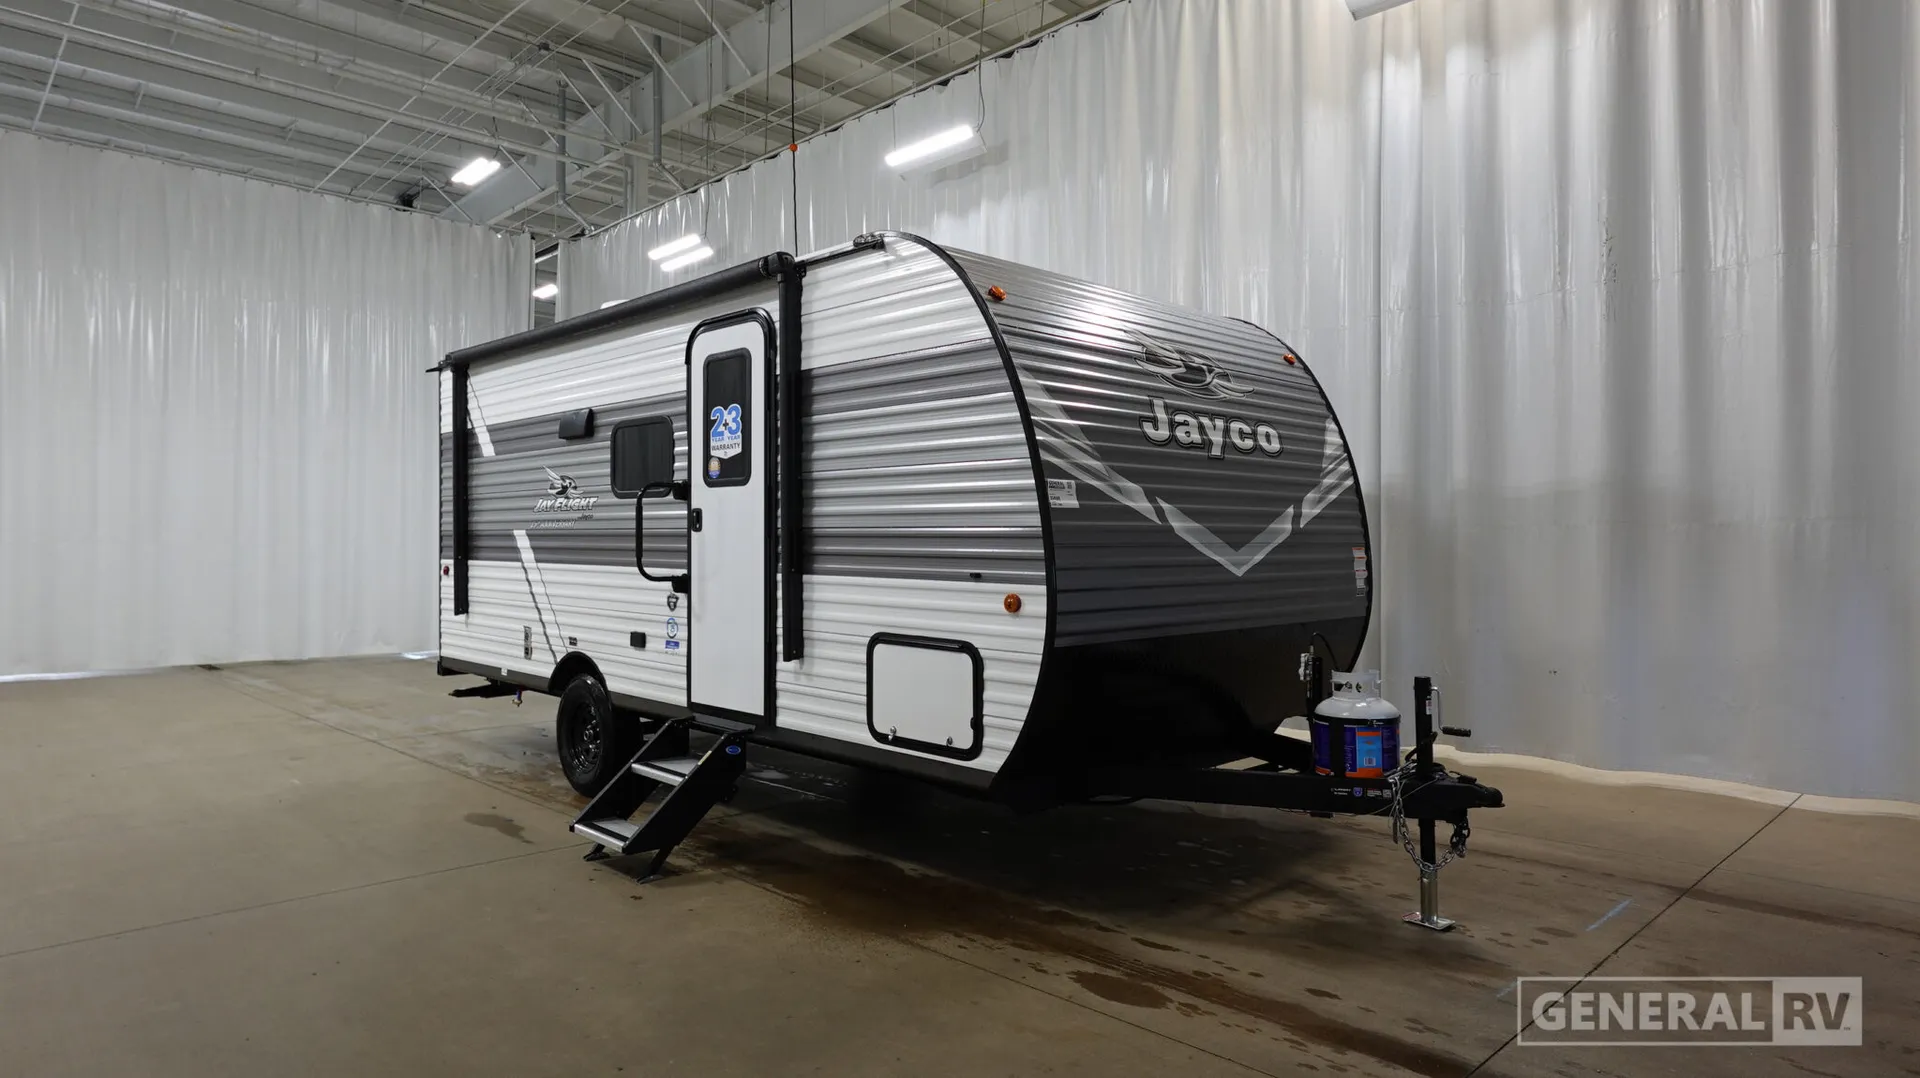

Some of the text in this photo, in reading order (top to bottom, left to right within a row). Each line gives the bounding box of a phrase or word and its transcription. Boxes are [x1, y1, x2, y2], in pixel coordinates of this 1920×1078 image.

[1140, 396, 1282, 458] Jayco
[712, 443, 740, 451] WARRANTY
[533, 497, 598, 512] JAY FLIGHT
